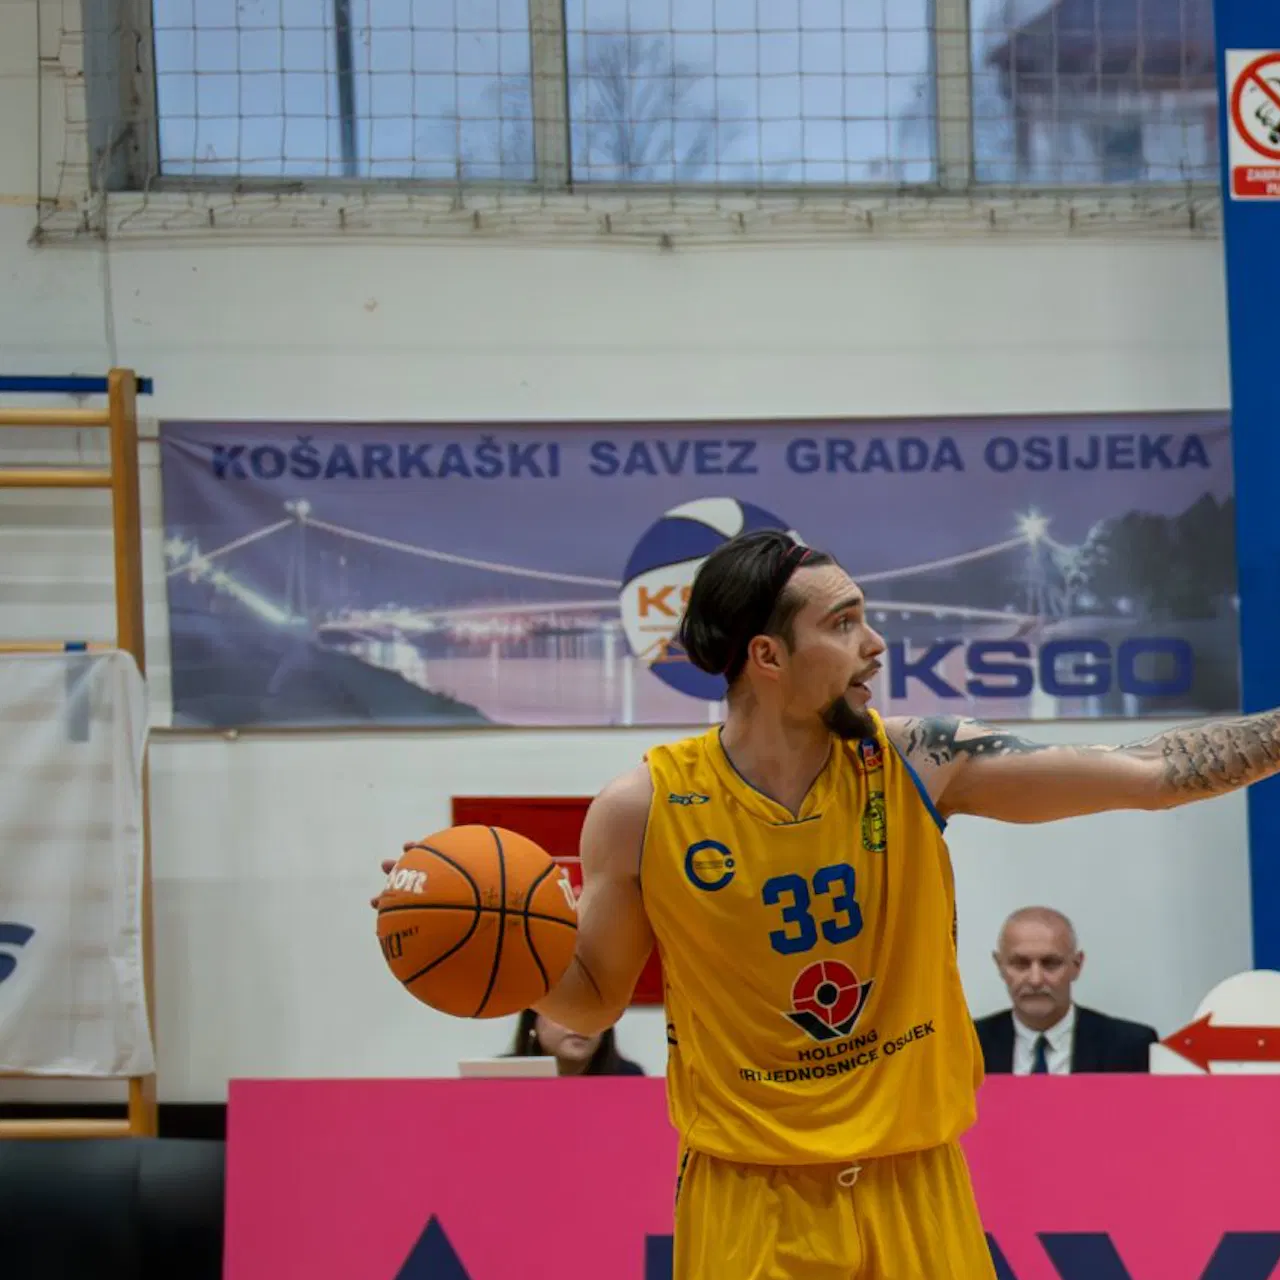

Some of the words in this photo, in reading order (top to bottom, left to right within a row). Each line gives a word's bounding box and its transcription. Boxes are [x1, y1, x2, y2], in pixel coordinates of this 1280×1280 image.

[213, 435, 560, 481] KOŠARKAŠKI
[589, 439, 758, 477] SAVEZ
[786, 436, 965, 474] GRADA
[983, 432, 1212, 472] OSIJEKA
[889, 635, 1196, 700] KSGO
[762, 862, 864, 956] 33
[797, 1029, 878, 1062] HOLDING
